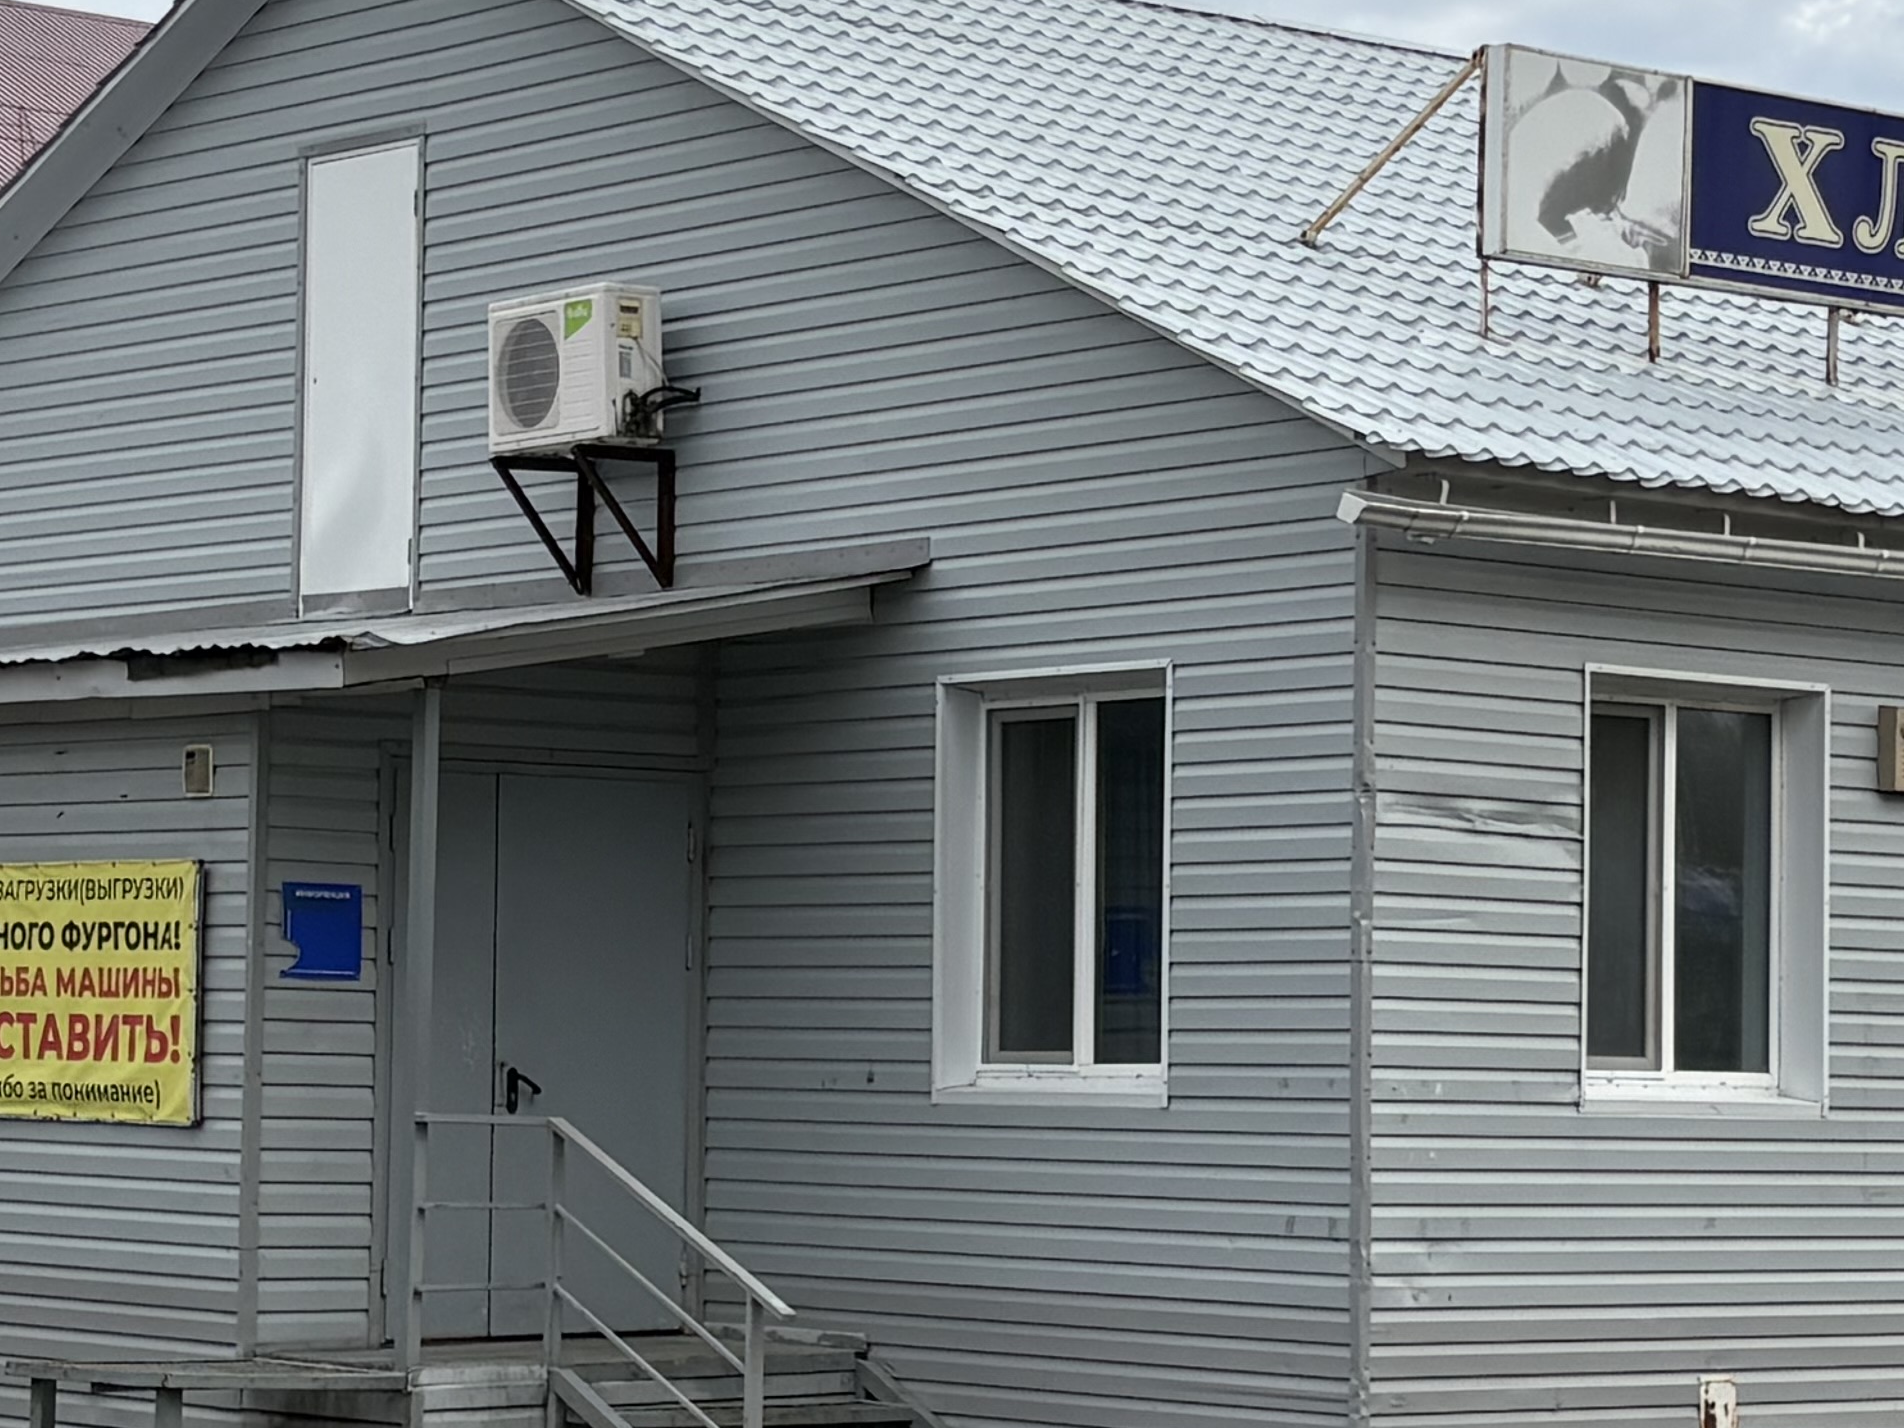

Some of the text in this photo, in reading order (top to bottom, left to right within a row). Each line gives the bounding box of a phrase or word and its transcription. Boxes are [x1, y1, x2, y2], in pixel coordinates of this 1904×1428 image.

[61, 920, 181, 951] ФУРГОНА!
[56, 967, 180, 999] МАШИНЫ
[28, 1082, 47, 1100] за
[51, 1080, 161, 1109] понимание)
